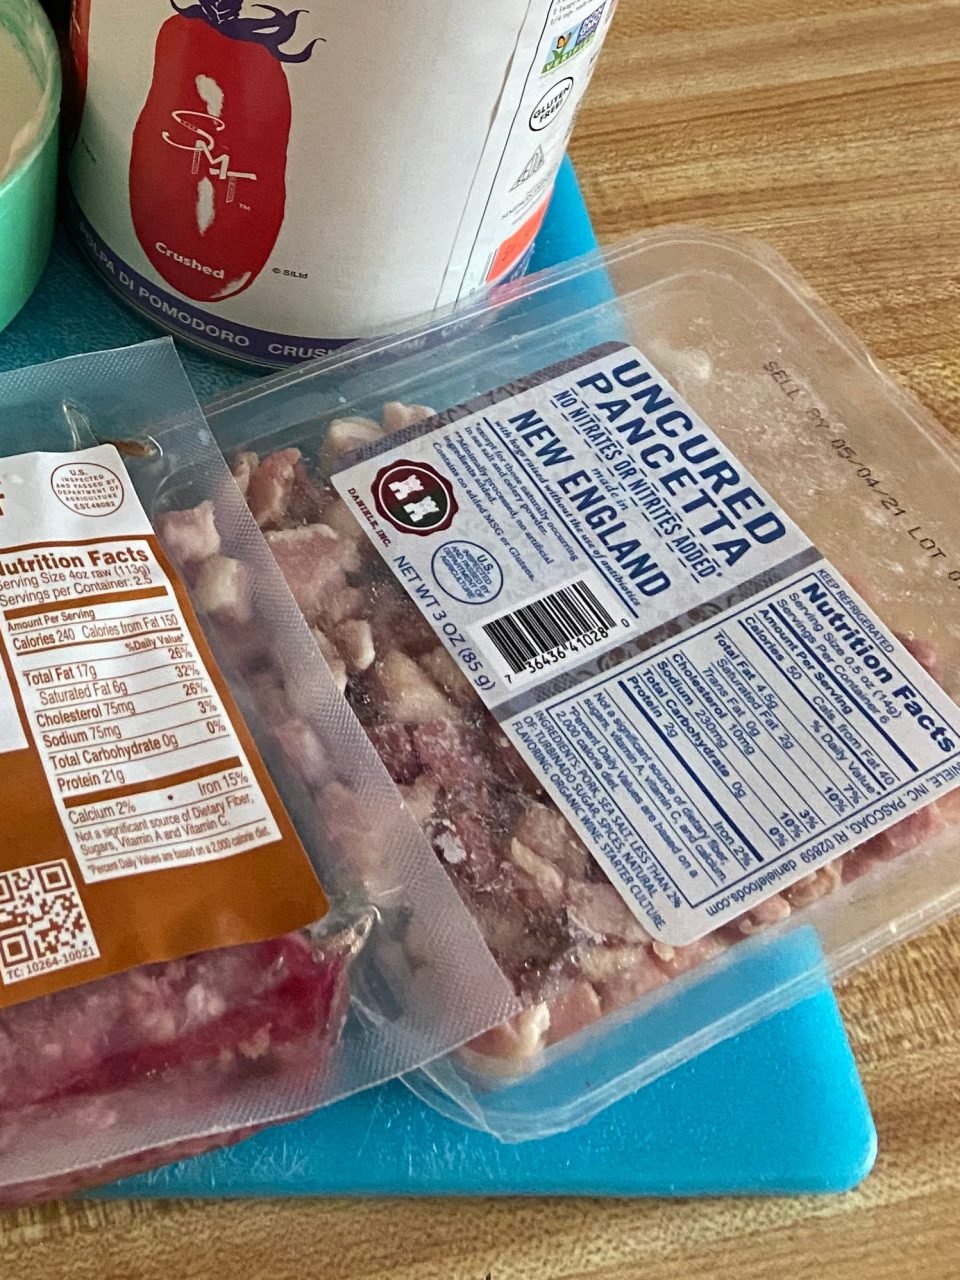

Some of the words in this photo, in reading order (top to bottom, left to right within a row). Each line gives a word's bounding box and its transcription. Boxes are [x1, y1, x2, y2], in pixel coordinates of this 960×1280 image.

[533, 84, 570, 119] GLUTEN
[155, 241, 225, 280] Crushed
[119, 274, 135, 290] DI
[139, 286, 250, 347] POMODORO
[552, 389, 578, 408] NO
[567, 406, 623, 461] NITRATES
[610, 460, 637, 479] OR
[626, 478, 683, 536] NITRITES
[574, 371, 759, 566] PANCETTA
[607, 358, 786, 547] UNCURED
[763, 360, 799, 400] SELL
[831, 438, 906, 516] 05/04/21
[908, 526, 947, 559] LOT
[506, 408, 575, 470] NEW
[554, 469, 674, 599] ENGLAND
[589, 467, 622, 499] made
[614, 498, 631, 511] in
[39, 569, 65, 583] Size
[68, 569, 88, 581] 4oz
[91, 568, 112, 578] raw
[113, 562, 151, 577] (113g)
[87, 545, 149, 566] Facts
[392, 555, 423, 586] NET
[52, 584, 71, 600] per
[72, 576, 132, 594] Container:
[132, 574, 153, 585] 2.5
[413, 584, 442, 613] WT
[12, 631, 56, 650] Calories
[55, 628, 76, 641] 240
[81, 622, 120, 638] Calories
[120, 618, 143, 634] from
[142, 616, 160, 629] Fat
[160, 613, 179, 627] 150
[432, 610, 447, 621] 3
[816, 567, 839, 591] KEEP
[835, 588, 895, 654] REFRIGERATED
[439, 621, 465, 646] OZ
[503, 674, 514, 684] 7
[526, 649, 567, 673] 36436
[569, 629, 609, 653] 41028
[619, 617, 631, 628] 0
[23, 669, 54, 687] Total
[54, 665, 75, 680] Fat
[75, 662, 97, 677] 17g
[167, 645, 192, 659] 26%
[455, 646, 484, 673] (85
[775, 598, 819, 644] Servings
[814, 643, 835, 663] Per
[832, 663, 881, 714] Container
[878, 714, 889, 724] 6
[787, 591, 825, 632] Serving
[821, 631, 847, 657] Size
[843, 655, 863, 674] 0.5
[859, 674, 875, 690] oz
[871, 689, 903, 720] (14g)
[800, 581, 895, 684] Nutrition
[892, 684, 958, 754] Facts
[473, 672, 497, 692] g)
[56, 772, 101, 792] Protein
[101, 767, 125, 783] 21g
[67, 803, 115, 826] Calcium
[115, 799, 137, 815] 2%
[196, 777, 221, 795] Iron
[221, 770, 249, 788] 15%
[704, 855, 798, 919] danielefoods.com
[7, 967, 24, 979] TC:
[27, 946, 95, 973] 10264-10021
